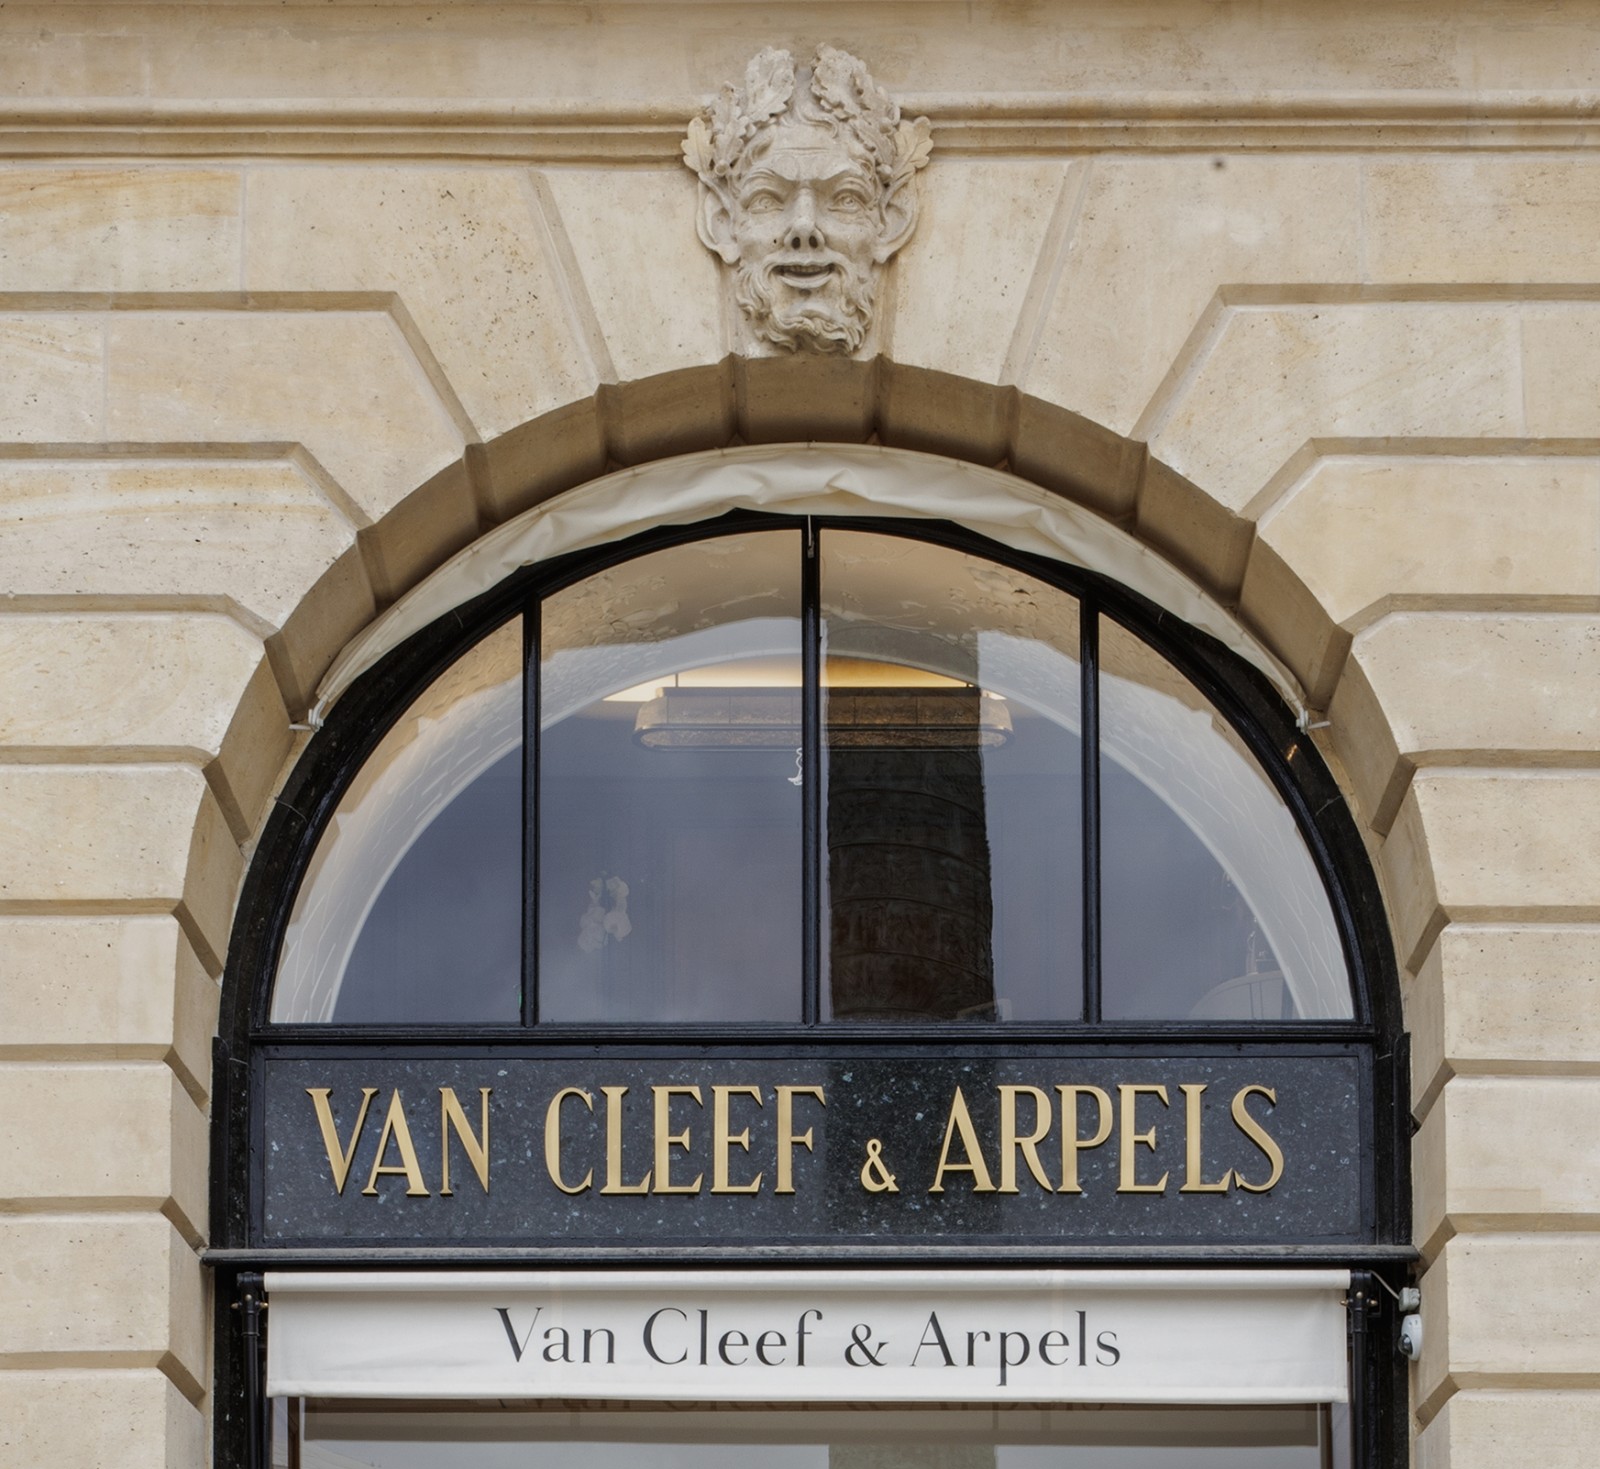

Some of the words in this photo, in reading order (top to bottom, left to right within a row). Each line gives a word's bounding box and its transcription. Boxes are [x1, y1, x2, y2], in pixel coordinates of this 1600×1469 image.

[307, 1087, 490, 1196] VAN
[544, 1085, 825, 1194] CLEEF
[861, 1138, 898, 1192] &
[929, 1084, 1284, 1193] ARPELS
[493, 1307, 617, 1365] Van
[642, 1308, 822, 1367] Cleef
[844, 1324, 889, 1367] &
[911, 1309, 1122, 1386] Arpels
